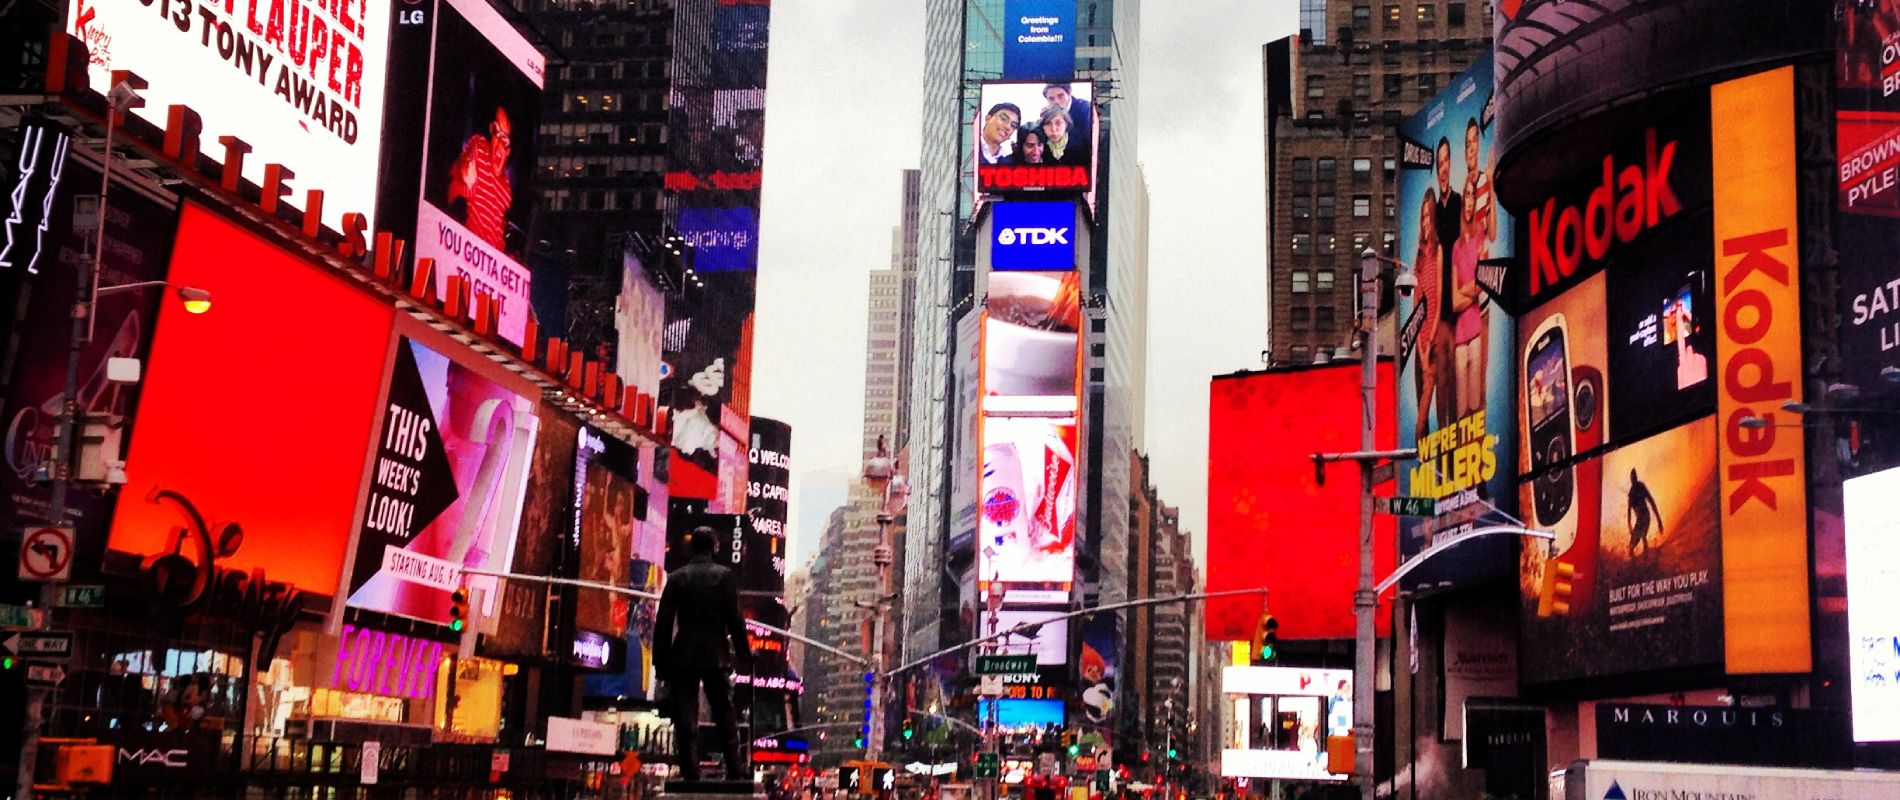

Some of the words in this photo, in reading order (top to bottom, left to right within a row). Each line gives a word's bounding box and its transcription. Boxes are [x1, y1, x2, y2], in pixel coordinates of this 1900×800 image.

[400, 10, 424, 24] LG
[1021, 16, 1059, 25] Greetings
[139, 0, 192, 32] 13
[199, 3, 273, 86] TONY
[274, 63, 358, 145] AWARD
[980, 166, 1088, 187] TOSHIBA
[1840, 136, 1900, 182] BROWN
[1848, 168, 1895, 207] PYLE
[1529, 127, 1682, 296] Kodak
[1014, 228, 1068, 244] TDK
[438, 221, 462, 255] YOU
[464, 241, 499, 281] GOTTA
[501, 265, 521, 294] GET
[1722, 228, 1795, 516] Kodak
[386, 403, 431, 462] THIS
[1418, 427, 1458, 460] WE'RE
[1458, 410, 1486, 447] THE
[377, 457, 421, 496] WEEK'S
[1410, 436, 1496, 499] MILLERS
[366, 492, 415, 538] LOOK!
[1394, 500, 1402, 511] W
[1406, 500, 1419, 514] 46
[390, 552, 428, 579] STARTING
[428, 563, 445, 584] AUG.
[1609, 586, 1626, 603] BUILT
[1628, 584, 1640, 598] FOR
[1642, 581, 1655, 596] THE
[1656, 578, 1671, 593] WAY
[1673, 575, 1688, 589] YOU
[332, 624, 442, 700] FOREVER
[1004, 673, 1040, 683] SONY
[766, 678, 785, 689] ABC
[1614, 708, 1783, 727] MARQUIS
[118, 748, 188, 767] MAC
[1633, 788, 1670, 800] IRON
